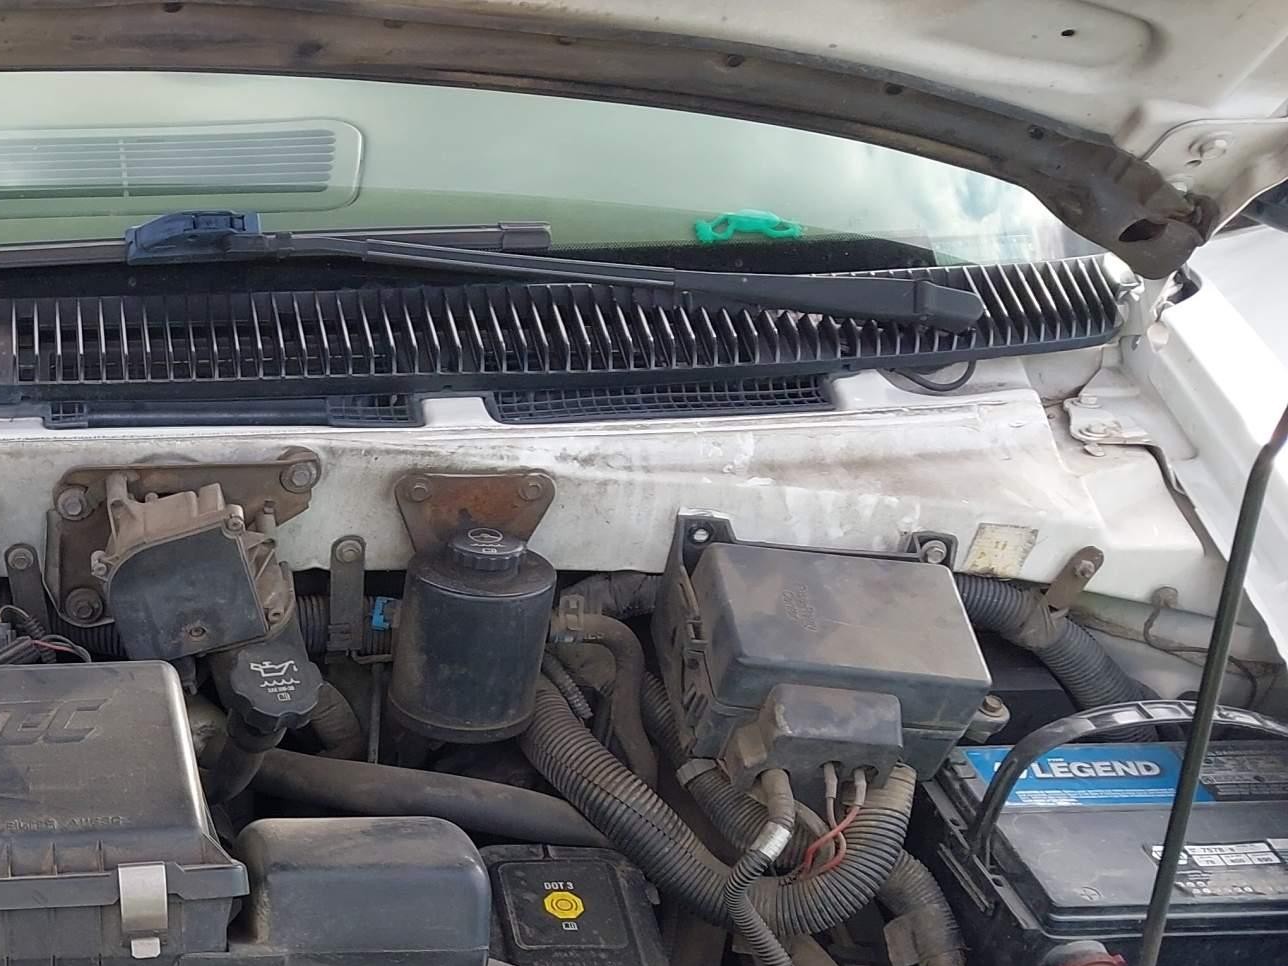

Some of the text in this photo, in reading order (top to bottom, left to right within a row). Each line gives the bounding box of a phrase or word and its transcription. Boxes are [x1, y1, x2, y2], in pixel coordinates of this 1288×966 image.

[1031, 760, 1161, 778] LEGEND
[543, 881, 575, 890] DOT 3
